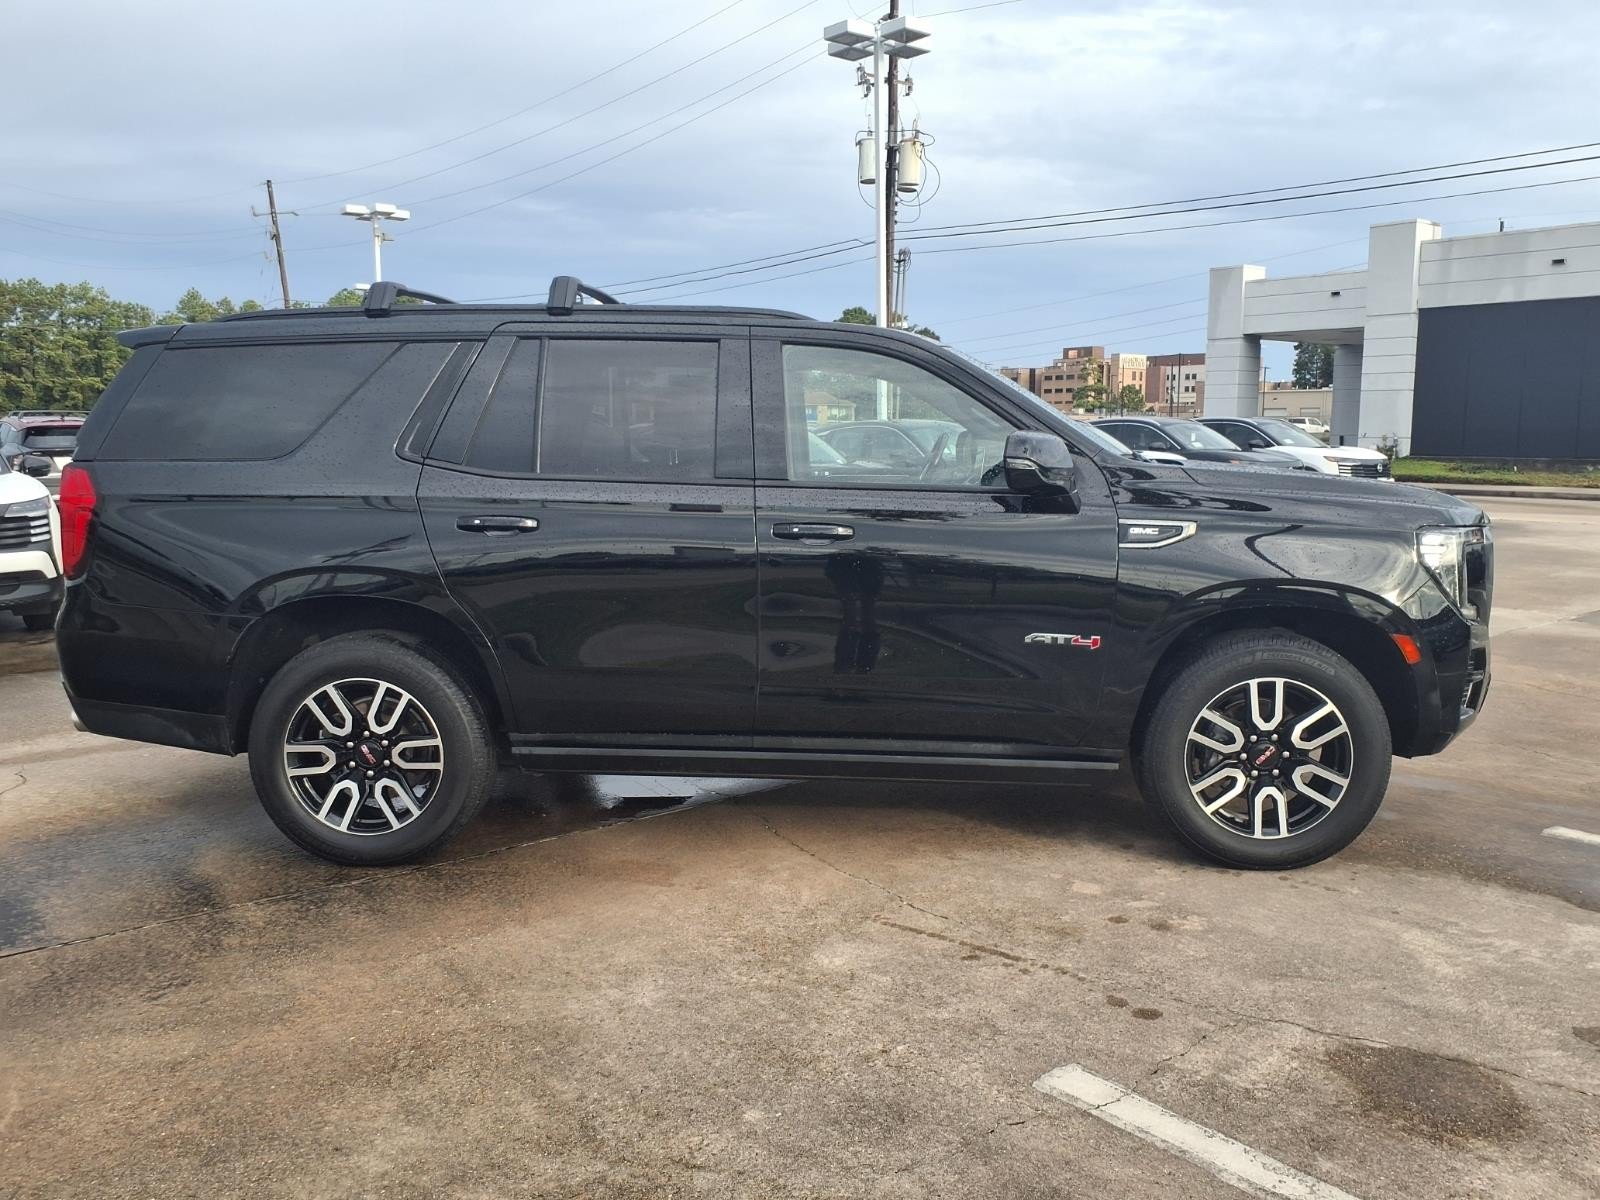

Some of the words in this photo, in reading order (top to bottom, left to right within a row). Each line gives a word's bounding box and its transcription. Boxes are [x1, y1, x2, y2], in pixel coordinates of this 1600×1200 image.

[1129, 527, 1159, 535] GMC
[1024, 632, 1101, 650] AT4
[360, 744, 377, 765] GMC
